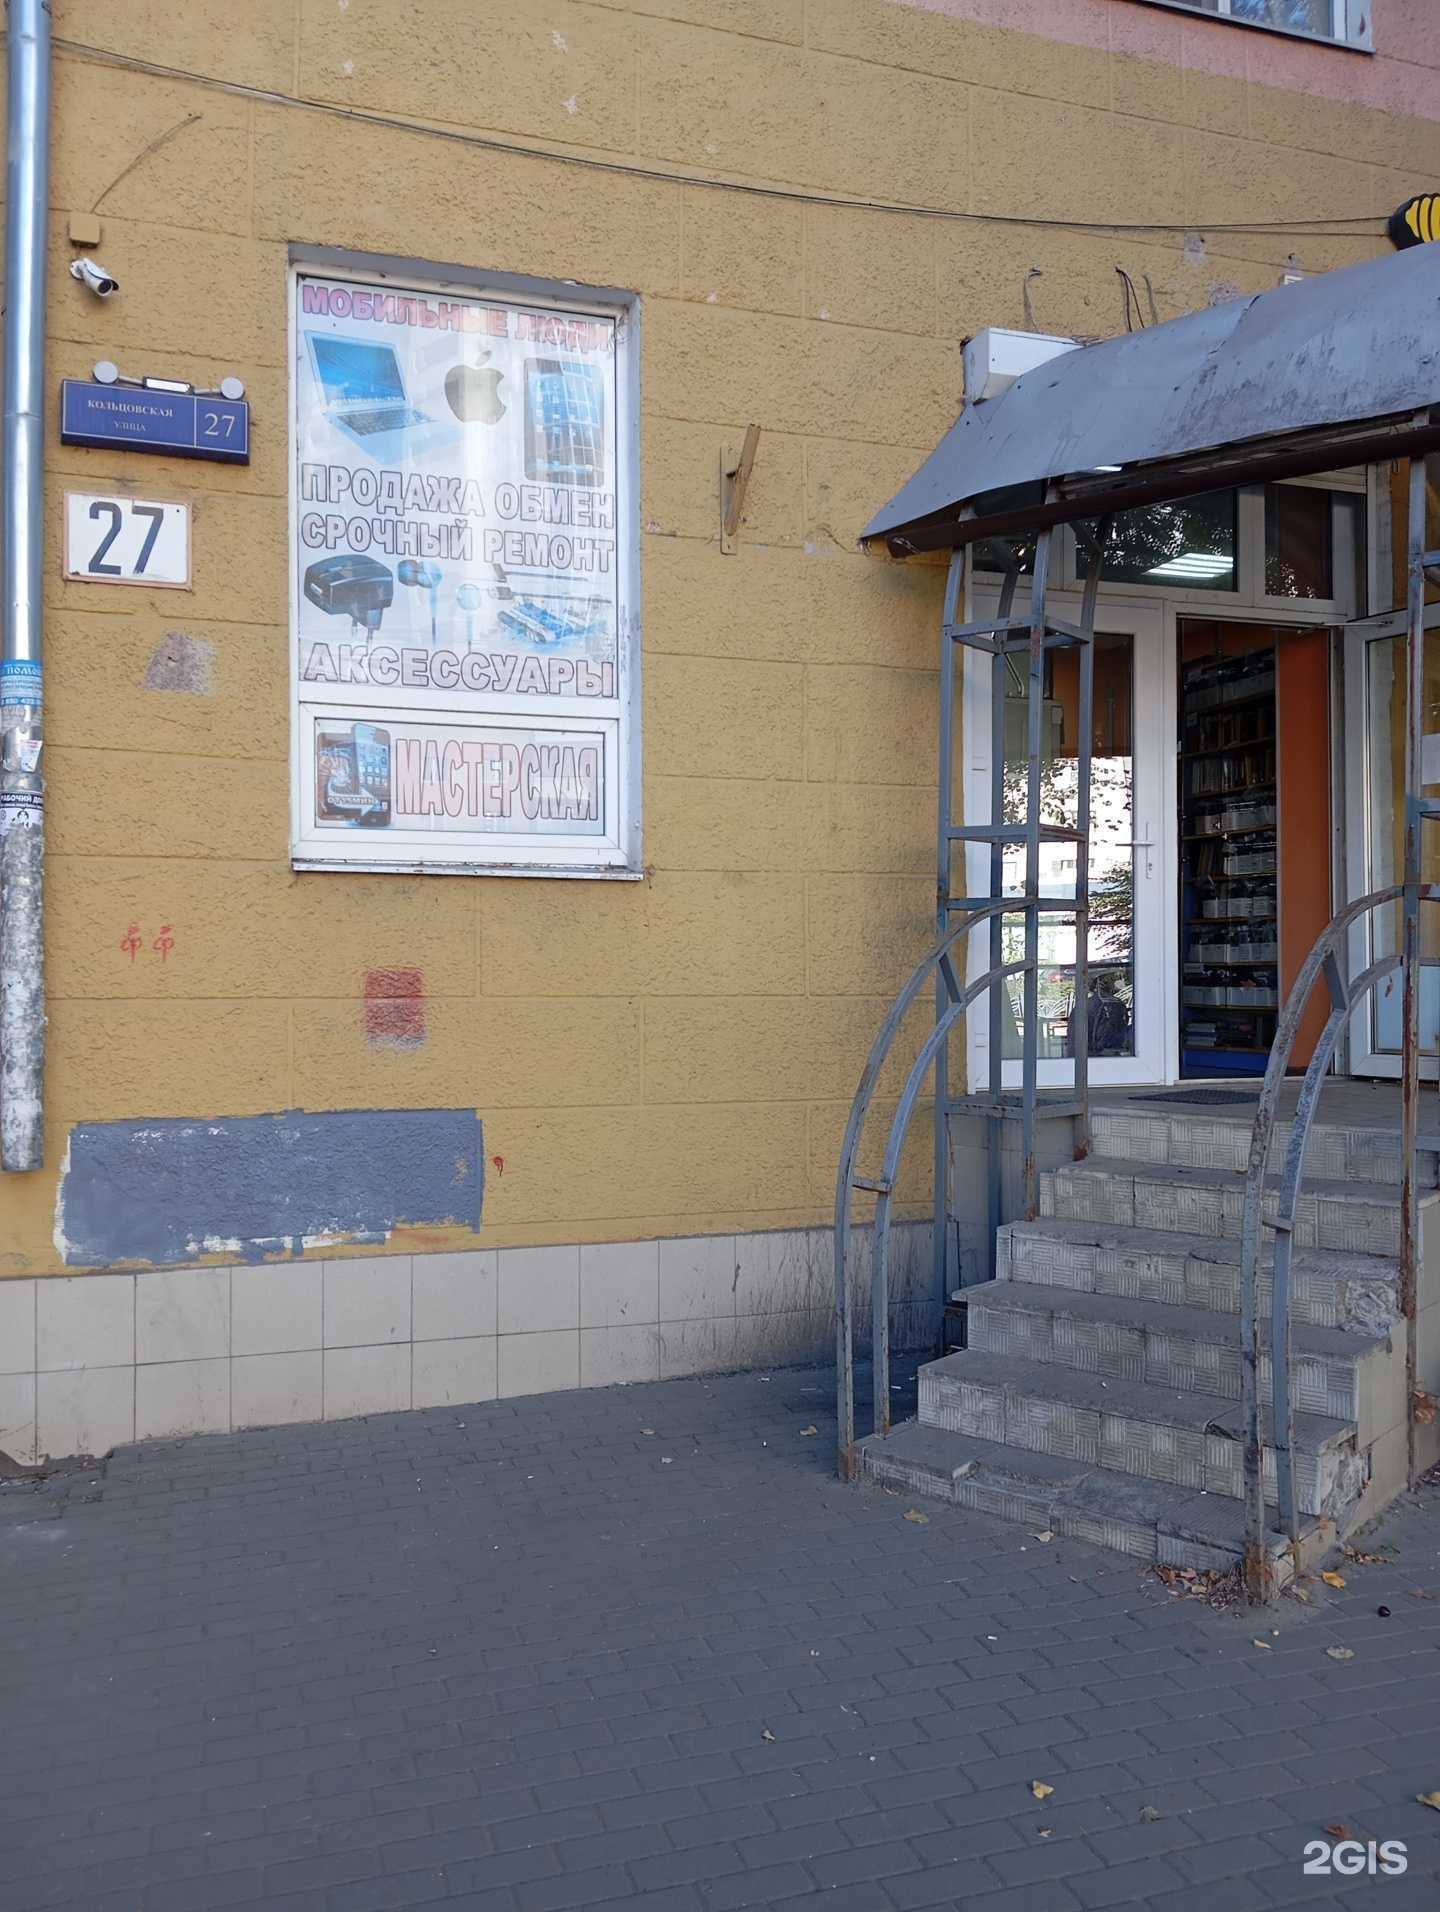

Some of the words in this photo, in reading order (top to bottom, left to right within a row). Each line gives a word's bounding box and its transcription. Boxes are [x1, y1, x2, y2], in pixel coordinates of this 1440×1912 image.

[302, 284, 509, 338] МОБИЛЬНЫЕ
[87, 399, 174, 418] КОЛЬЦОВСКАЯ
[113, 420, 147, 432] УЛИЦА
[204, 412, 236, 438] 27
[301, 463, 486, 518] ПРОДАЖА
[494, 482, 615, 530] ОБМЕН
[88, 500, 164, 576] 27
[301, 512, 474, 561] СРОЧНЫЙ
[483, 528, 615, 573] РЕМОНТ
[303, 642, 615, 698] АКСЕССУАРЫ
[395, 738, 600, 822] МАСТЕРСКАЯ
